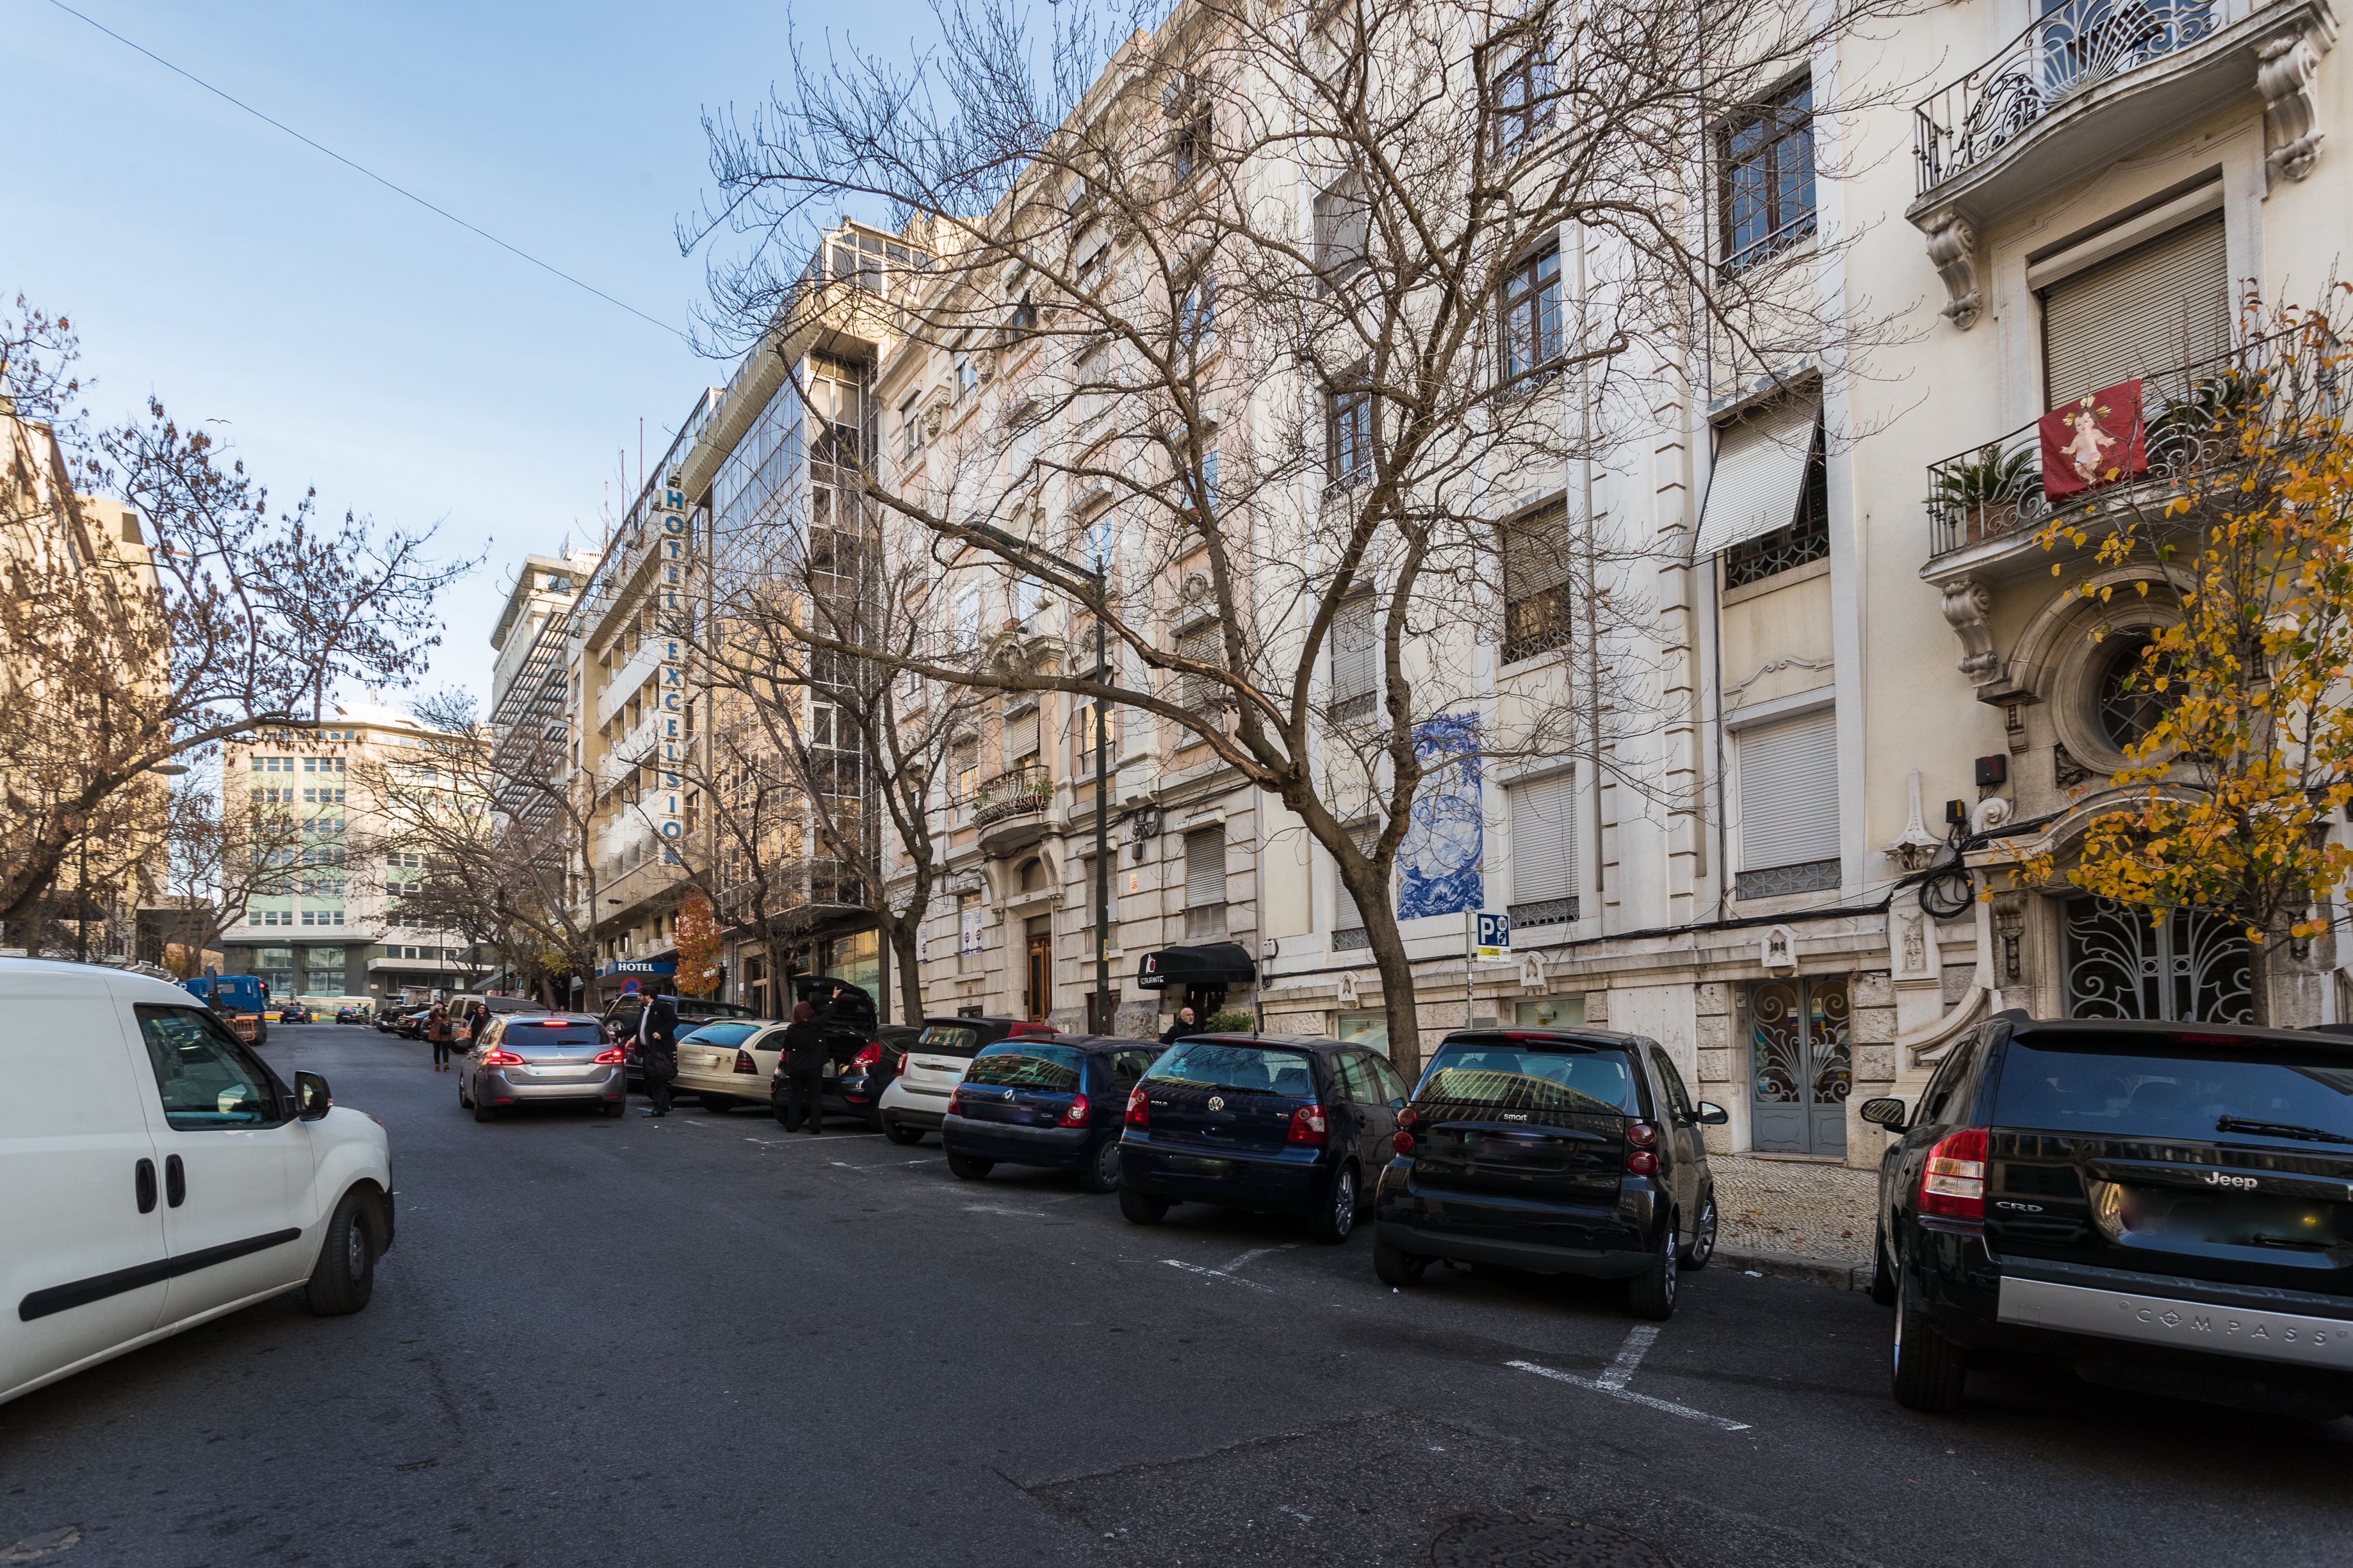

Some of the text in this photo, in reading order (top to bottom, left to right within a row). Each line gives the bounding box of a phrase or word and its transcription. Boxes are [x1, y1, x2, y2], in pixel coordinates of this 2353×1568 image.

[665, 490, 684, 604] HOTEL
[1481, 917, 1495, 944] P
[618, 962, 655, 972] HOTEL
[2204, 1172, 2258, 1191] Jeep
[1995, 1201, 2044, 1212] CRD
